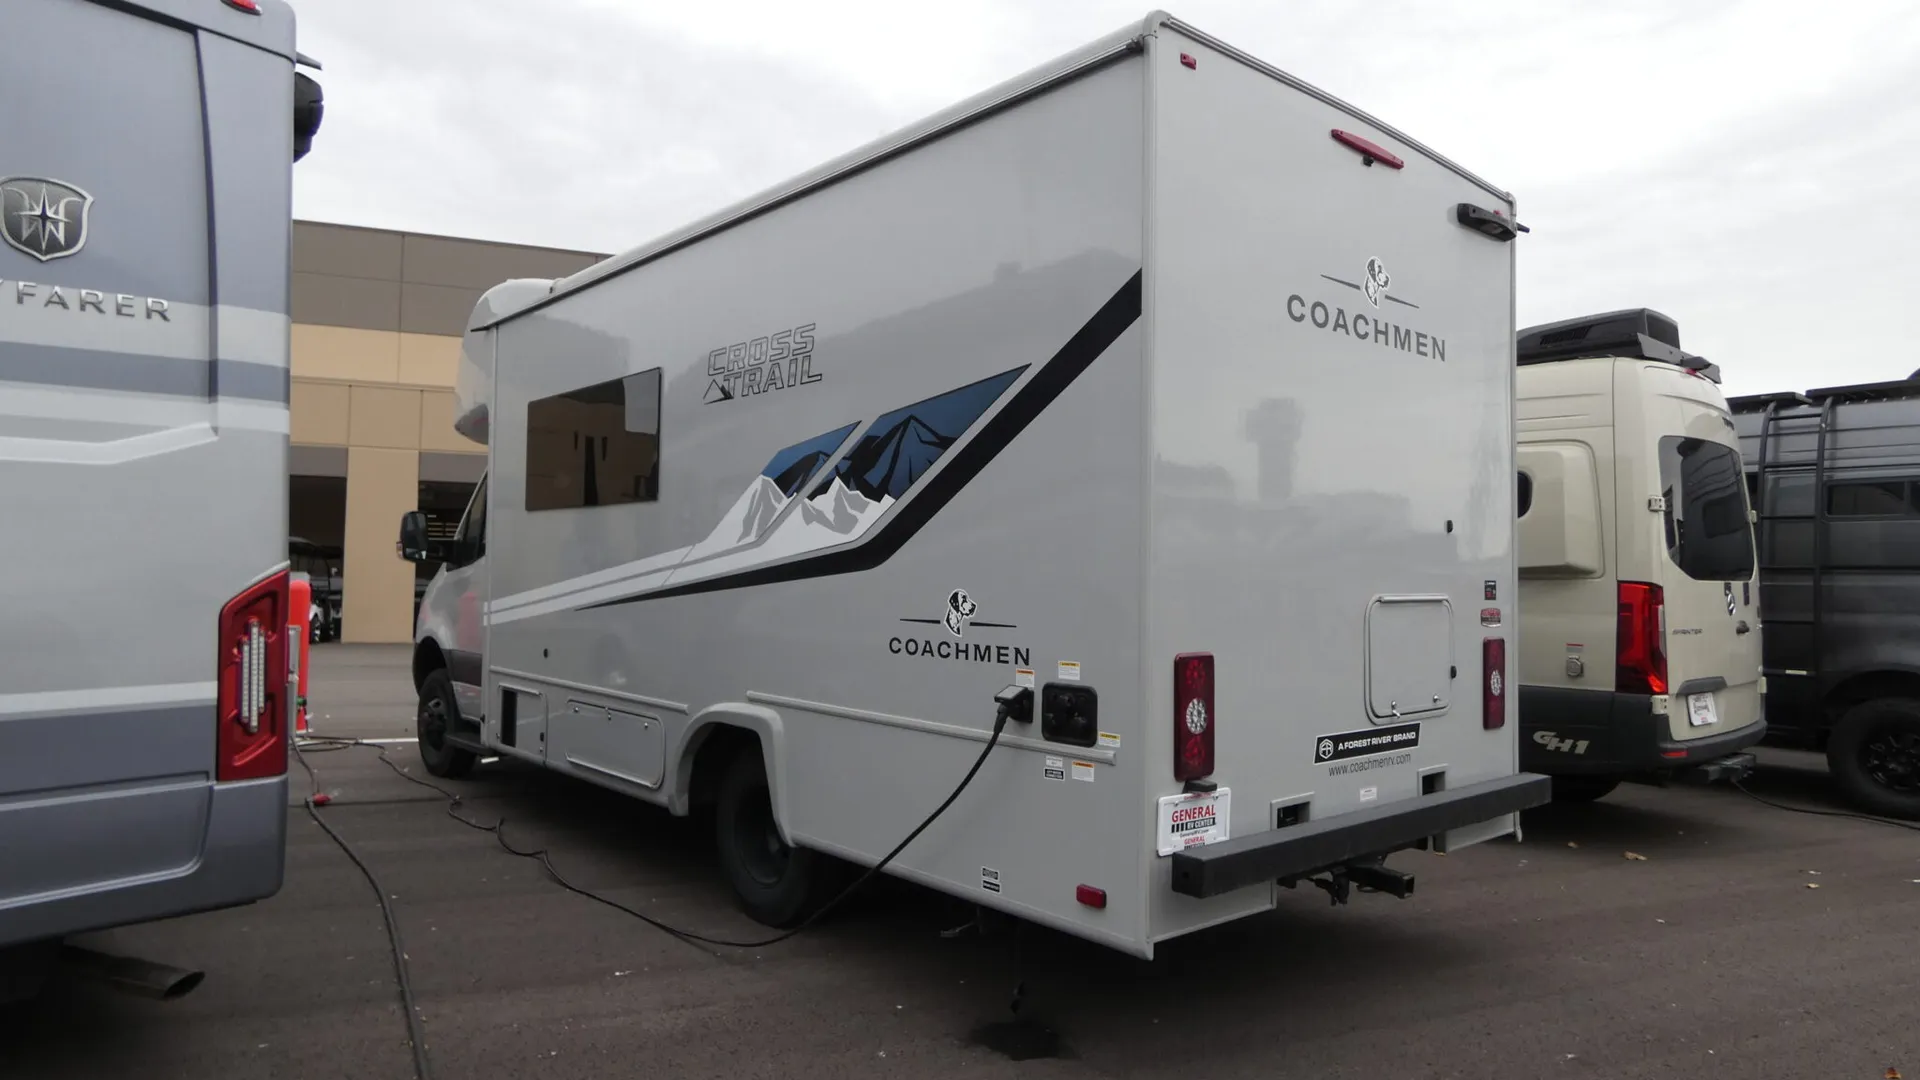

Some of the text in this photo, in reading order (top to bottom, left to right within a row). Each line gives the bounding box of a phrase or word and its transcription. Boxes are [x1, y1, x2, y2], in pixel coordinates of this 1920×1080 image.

[0, 279, 170, 322] FARER
[1287, 294, 1446, 362] COACHMEN
[708, 322, 816, 376] CROSS
[723, 354, 823, 399] TRAIL
[889, 637, 1030, 666] COACHMEN
[1338, 732, 1416, 751] A FOREST RIVER BRAND
[1532, 730, 1590, 755] GH1
[1328, 753, 1411, 777] www.coachmenrv.com
[1171, 804, 1216, 823] GENERAL
